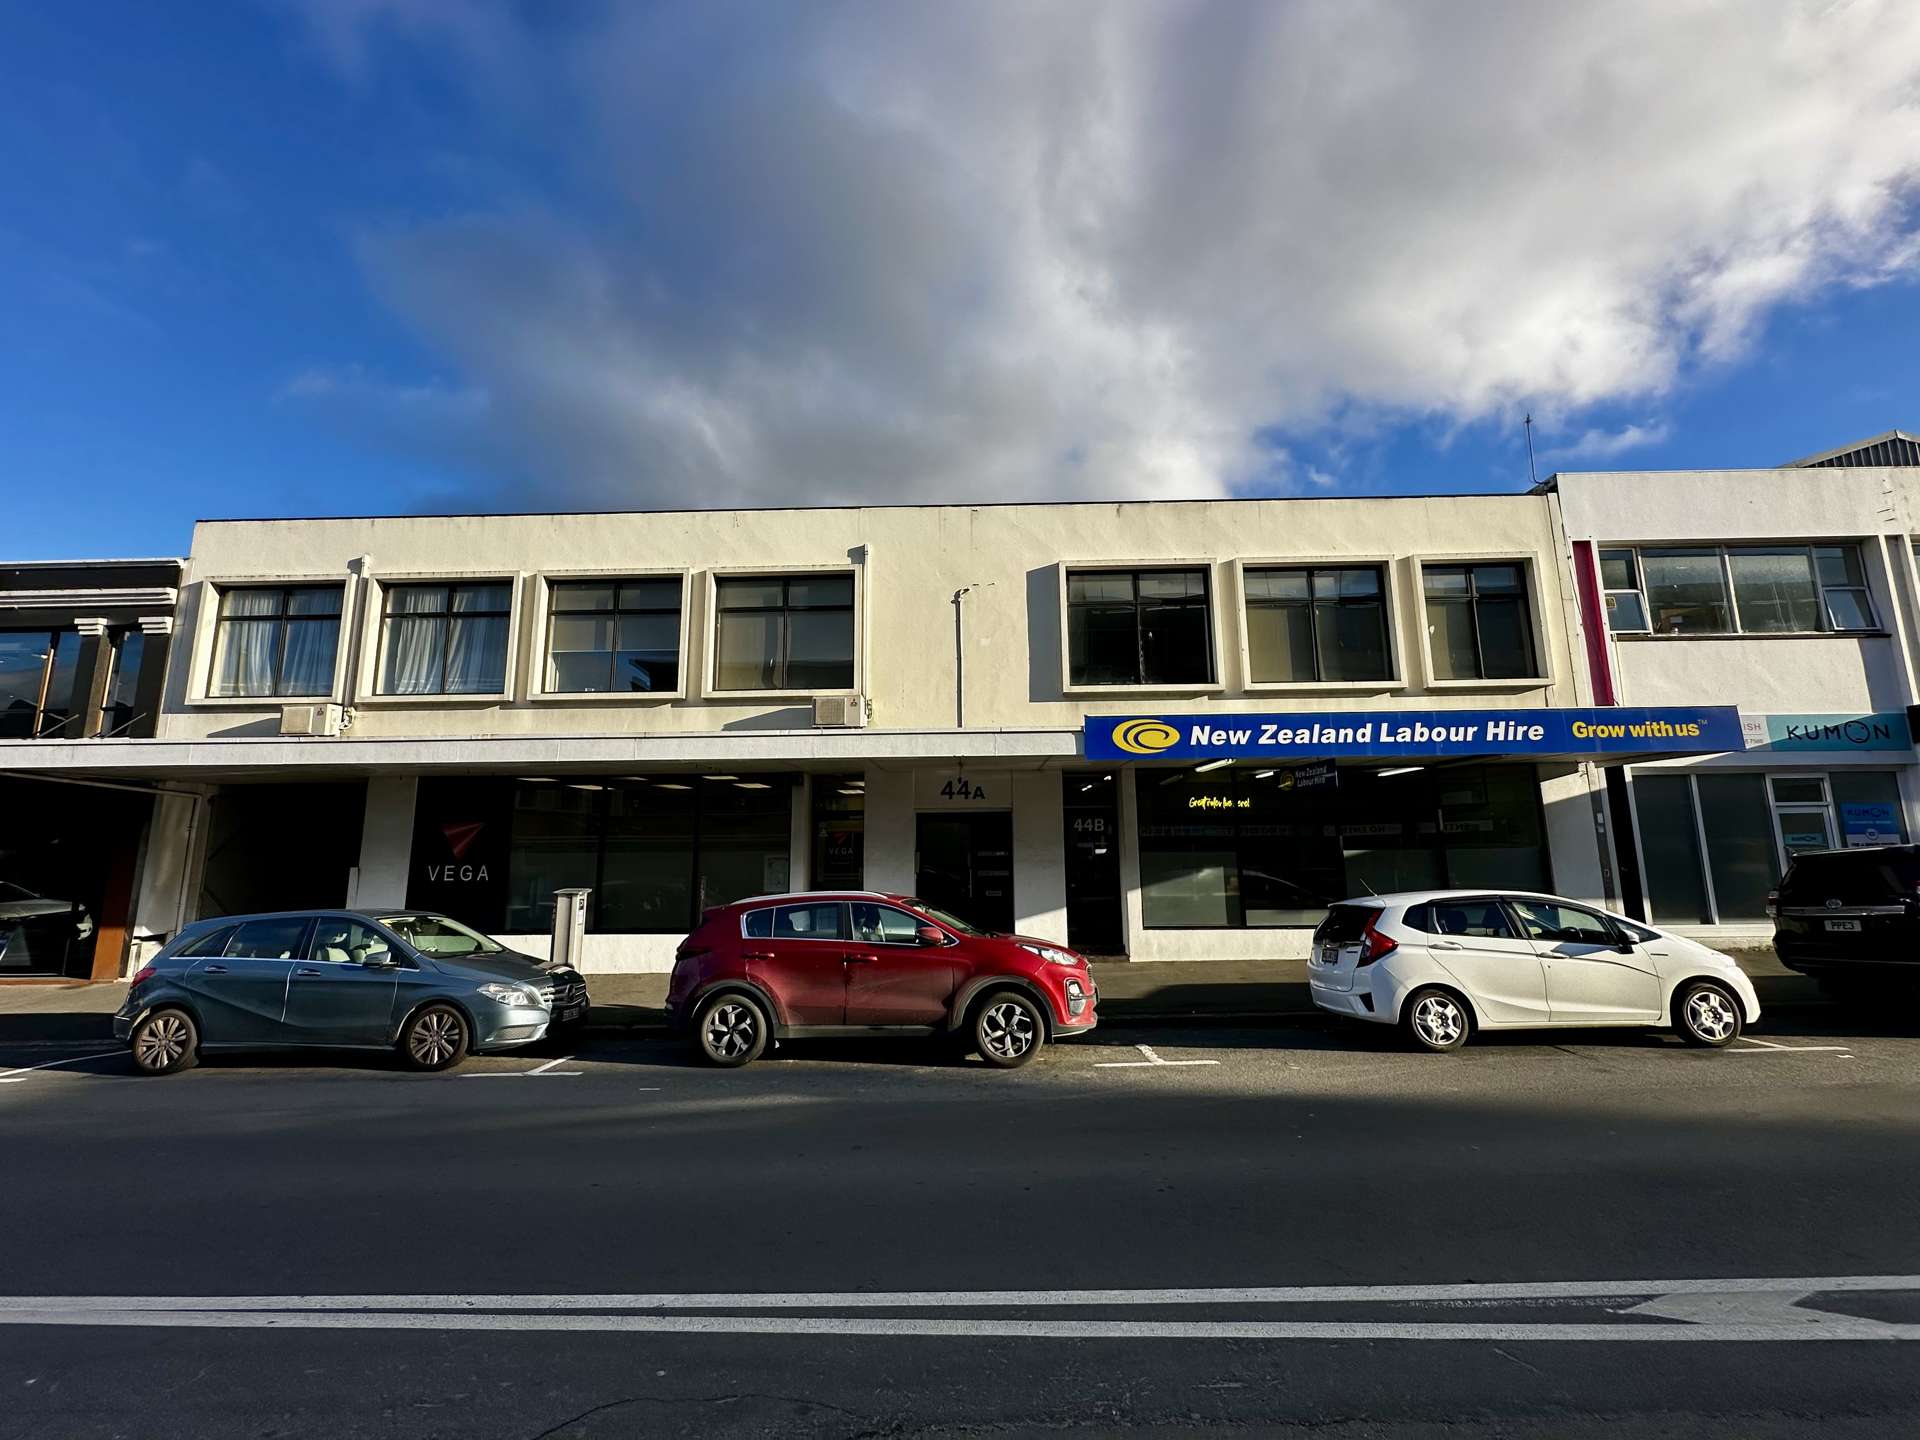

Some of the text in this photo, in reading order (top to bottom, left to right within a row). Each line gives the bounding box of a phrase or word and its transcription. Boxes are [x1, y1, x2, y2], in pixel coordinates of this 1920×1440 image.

[1190, 719, 1545, 746] New Zealand Labour Hire
[1571, 721, 1625, 739] Grow
[1630, 720, 1674, 737] with
[1676, 722, 1700, 736] us
[1786, 720, 1890, 743] KUMON
[1073, 817, 1105, 832] 44B
[428, 864, 489, 882] VEGA
